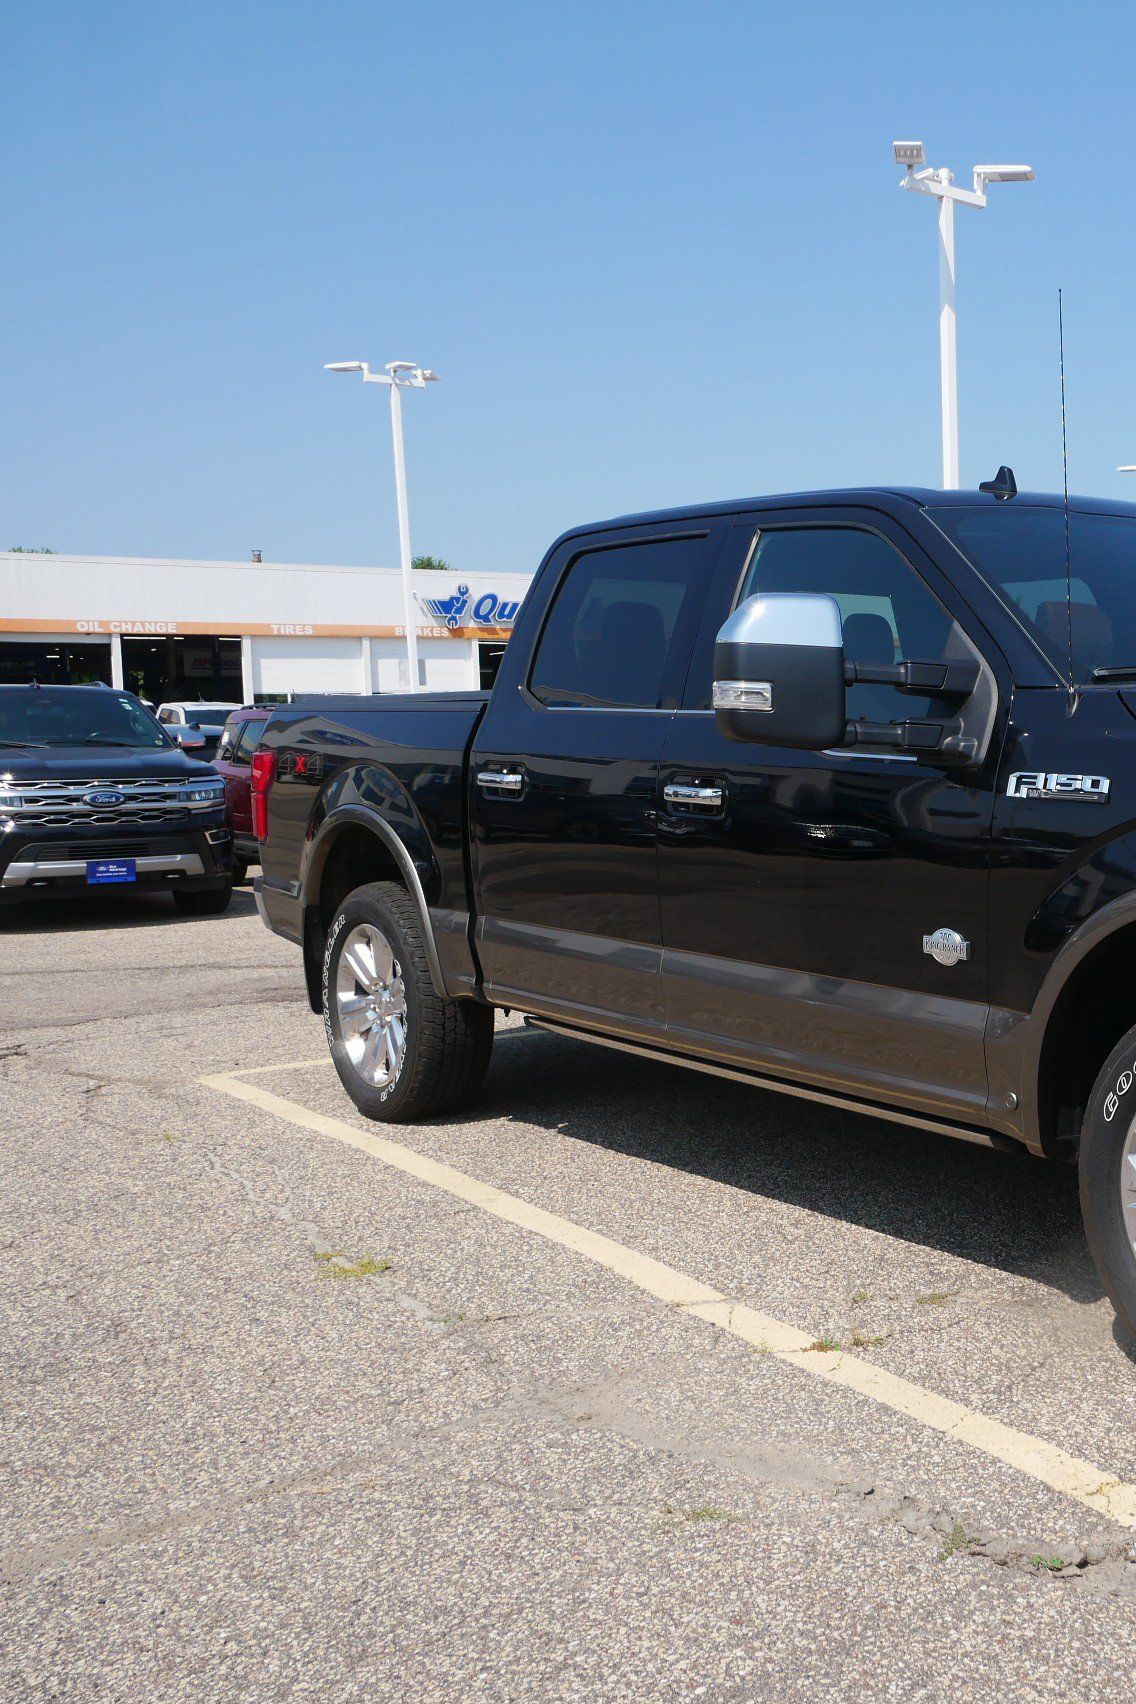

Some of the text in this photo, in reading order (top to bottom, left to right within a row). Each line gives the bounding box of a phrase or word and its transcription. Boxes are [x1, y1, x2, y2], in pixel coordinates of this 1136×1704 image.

[76, 621, 177, 633] OIL CHANGE
[270, 624, 314, 635] TIRES
[395, 626, 450, 637] BAKES
[925, 938, 966, 957] KING RANCH
